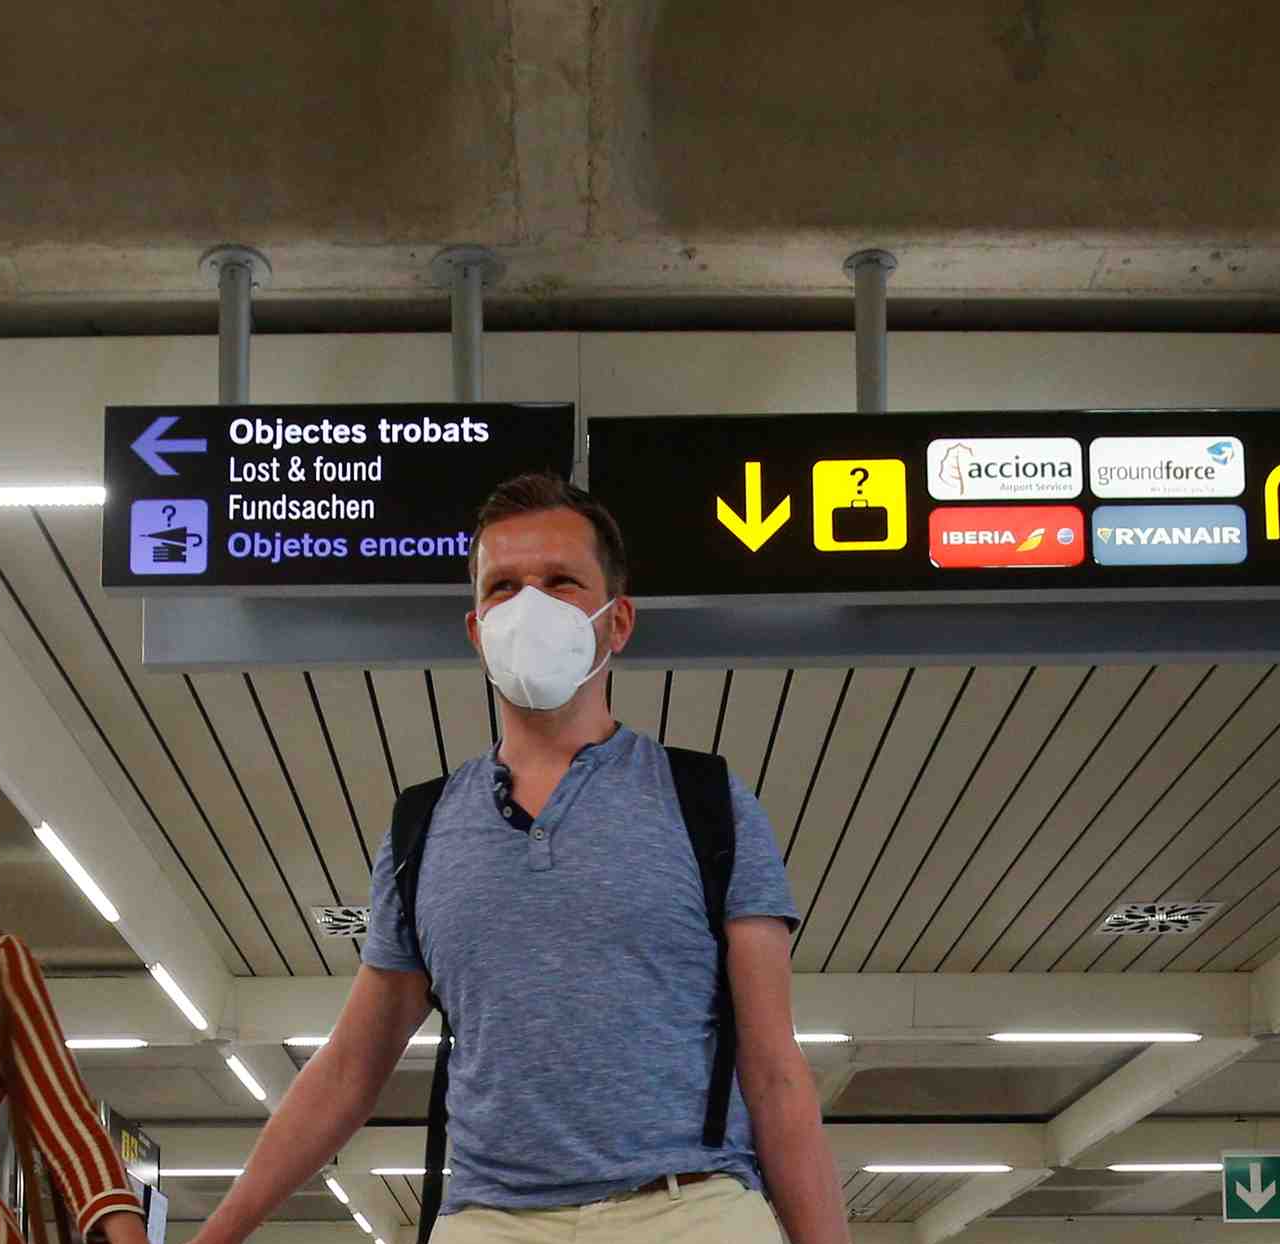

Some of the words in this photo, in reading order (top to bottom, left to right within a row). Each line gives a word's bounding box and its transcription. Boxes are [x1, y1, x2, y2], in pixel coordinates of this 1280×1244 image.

[229, 418, 367, 447] Objectes
[379, 417, 489, 443] trobats
[229, 456, 280, 482] Lost
[287, 456, 307, 482] &
[313, 455, 382, 482] found
[968, 455, 1073, 479] acciona
[1097, 460, 1216, 486] groundforce
[1000, 482, 1034, 493] Airport
[1036, 481, 1073, 491] Services
[228, 494, 376, 521] Fundsachen
[228, 532, 348, 563] Objetos
[360, 531, 473, 557] encont
[942, 530, 1016, 545] IBERIA
[1115, 526, 1241, 545] RYANAIR
